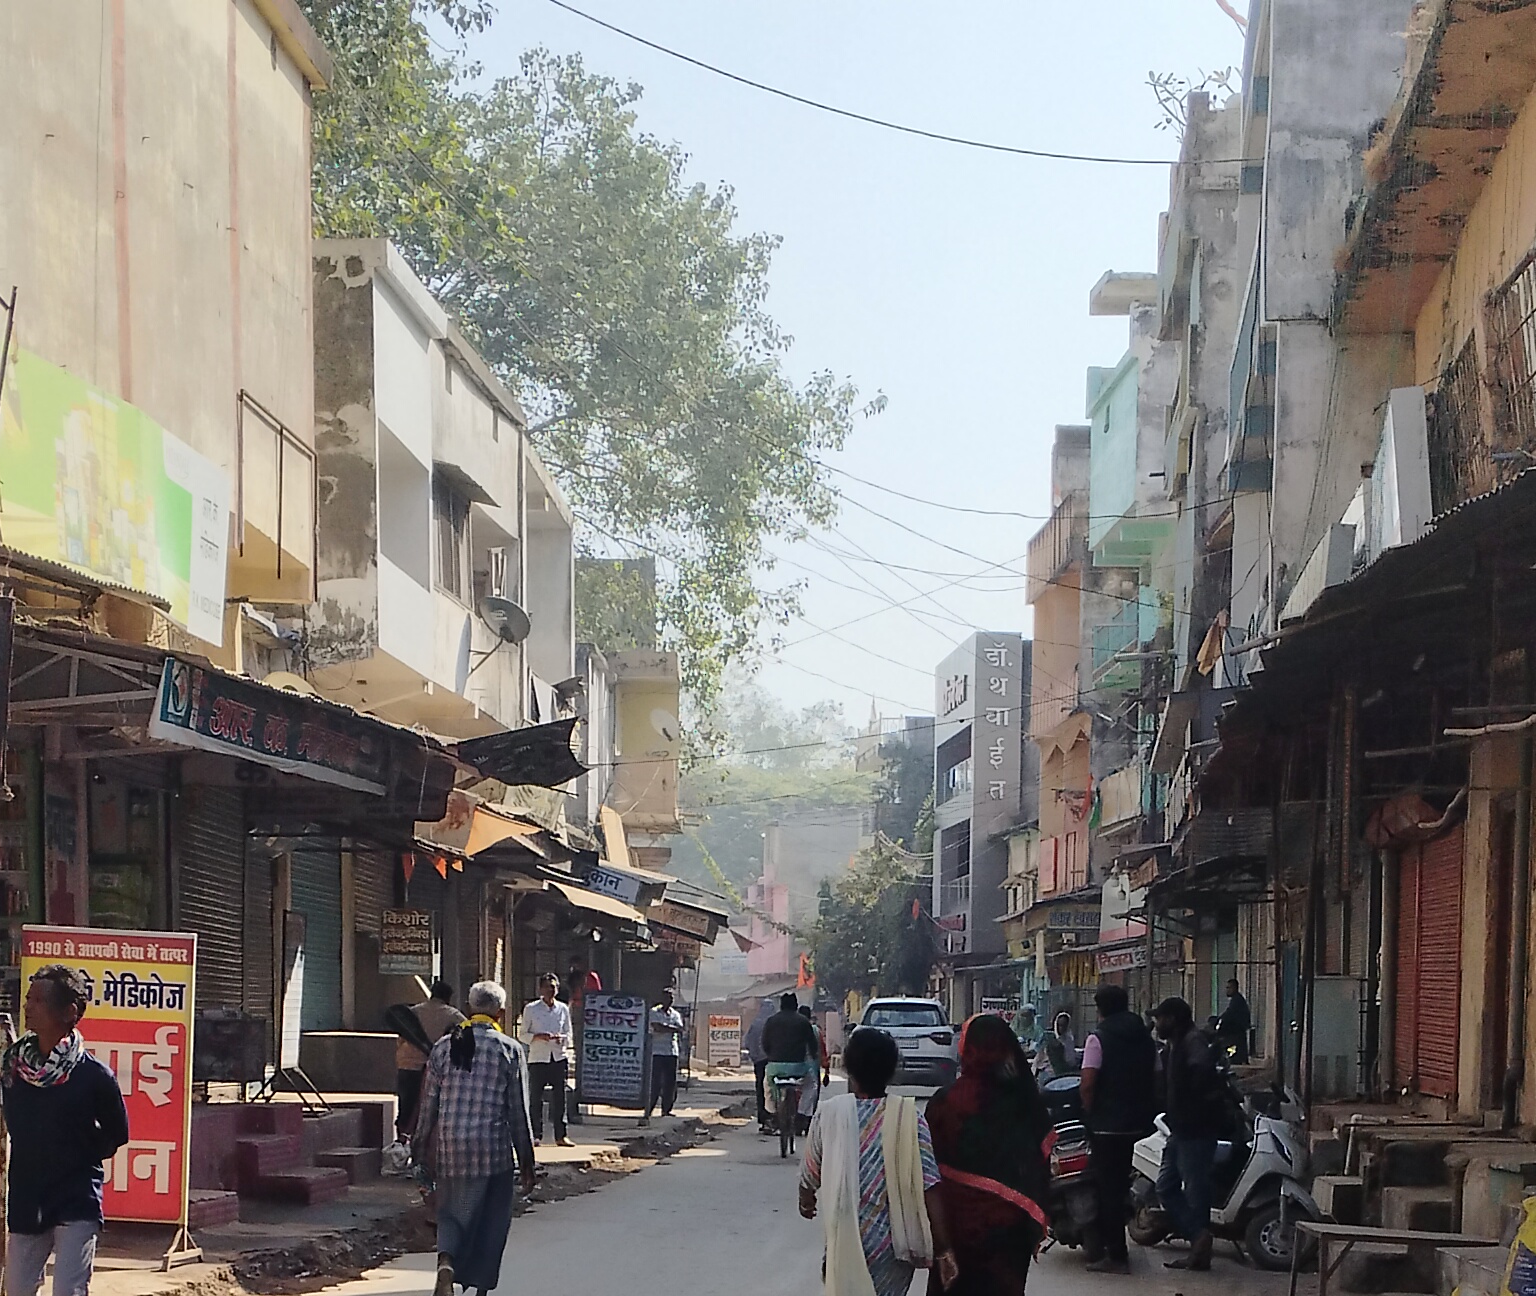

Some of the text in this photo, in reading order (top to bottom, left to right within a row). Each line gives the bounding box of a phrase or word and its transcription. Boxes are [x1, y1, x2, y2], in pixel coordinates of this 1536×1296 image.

[383, 909, 429, 926] किशोर
[28, 939, 188, 962] 1990 से आपकी सेवा में तत्पर
[103, 970, 186, 1011] मेडिकोज
[585, 1044, 640, 1062] दुकान
